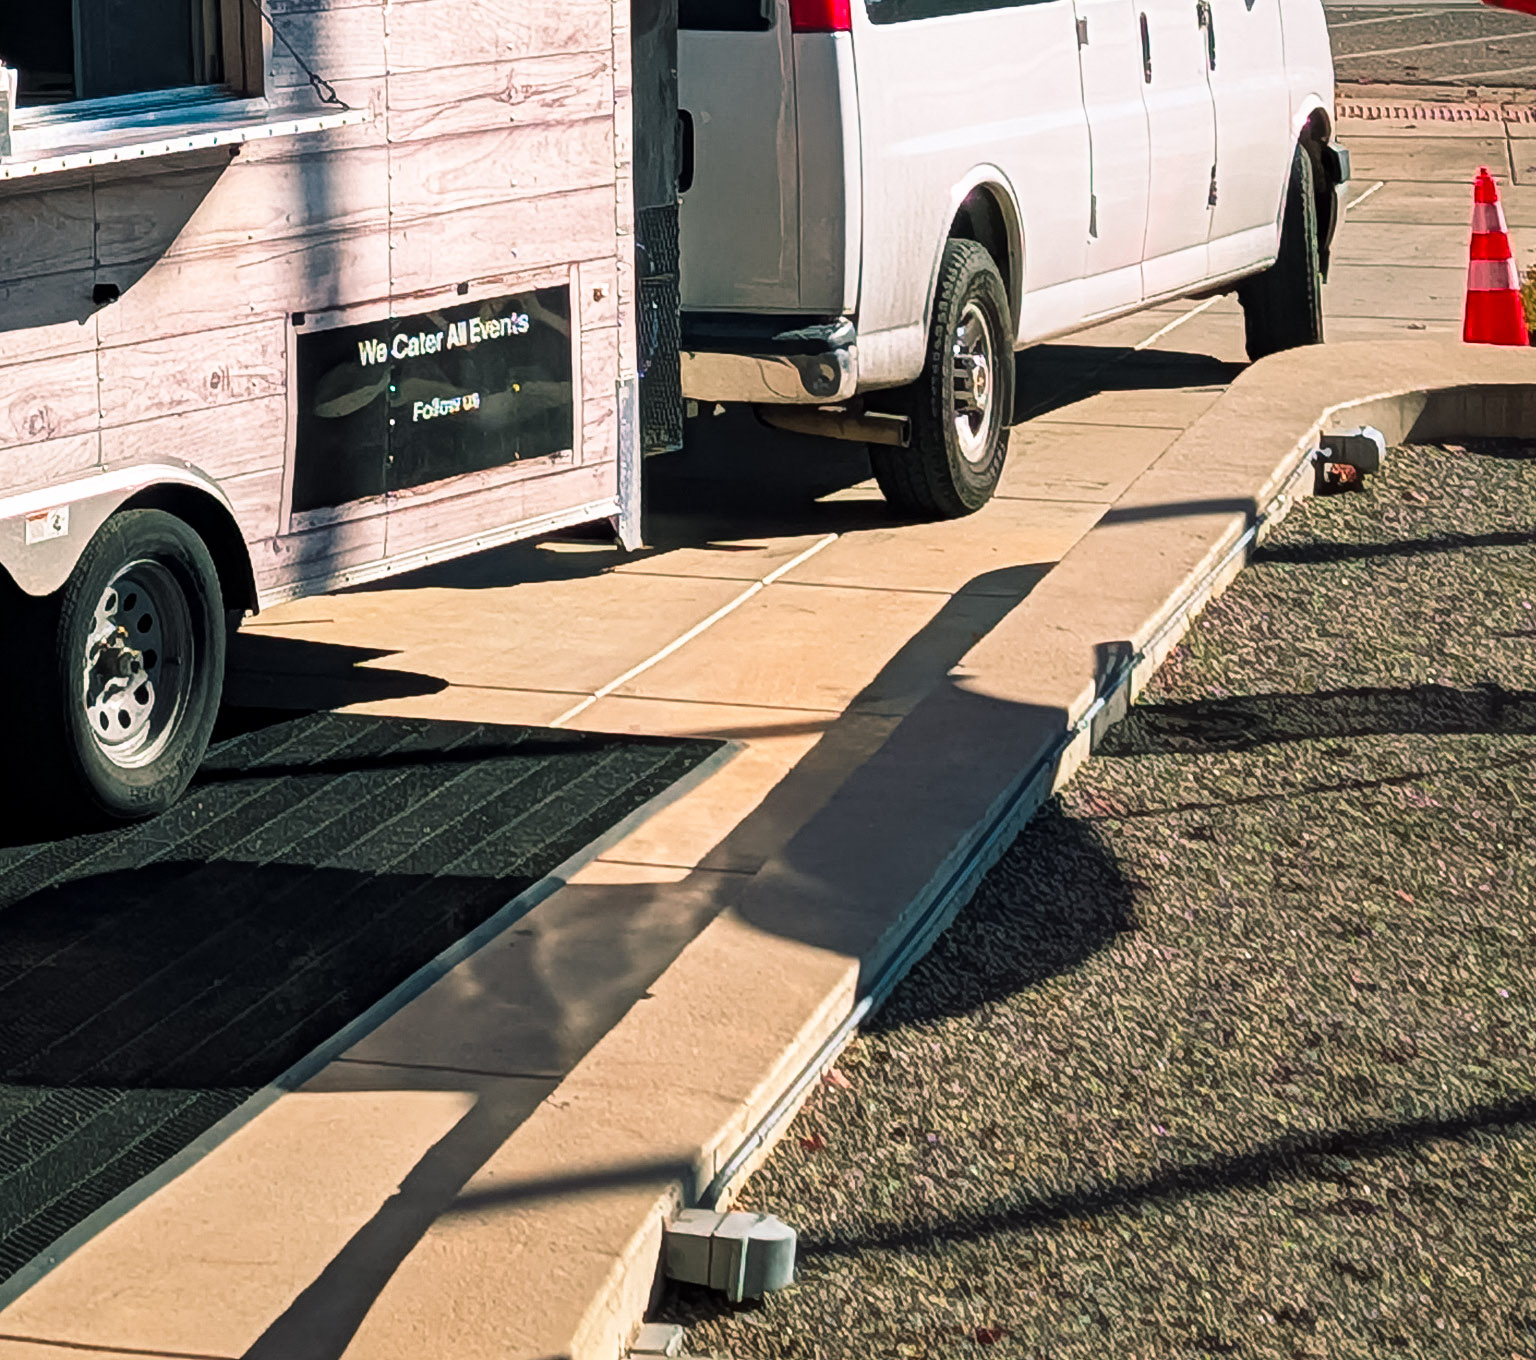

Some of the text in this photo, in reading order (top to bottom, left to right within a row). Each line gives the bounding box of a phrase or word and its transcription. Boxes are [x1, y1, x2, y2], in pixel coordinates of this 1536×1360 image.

[358, 312, 531, 367] We Cater All Events
[412, 392, 481, 422] Follow us
